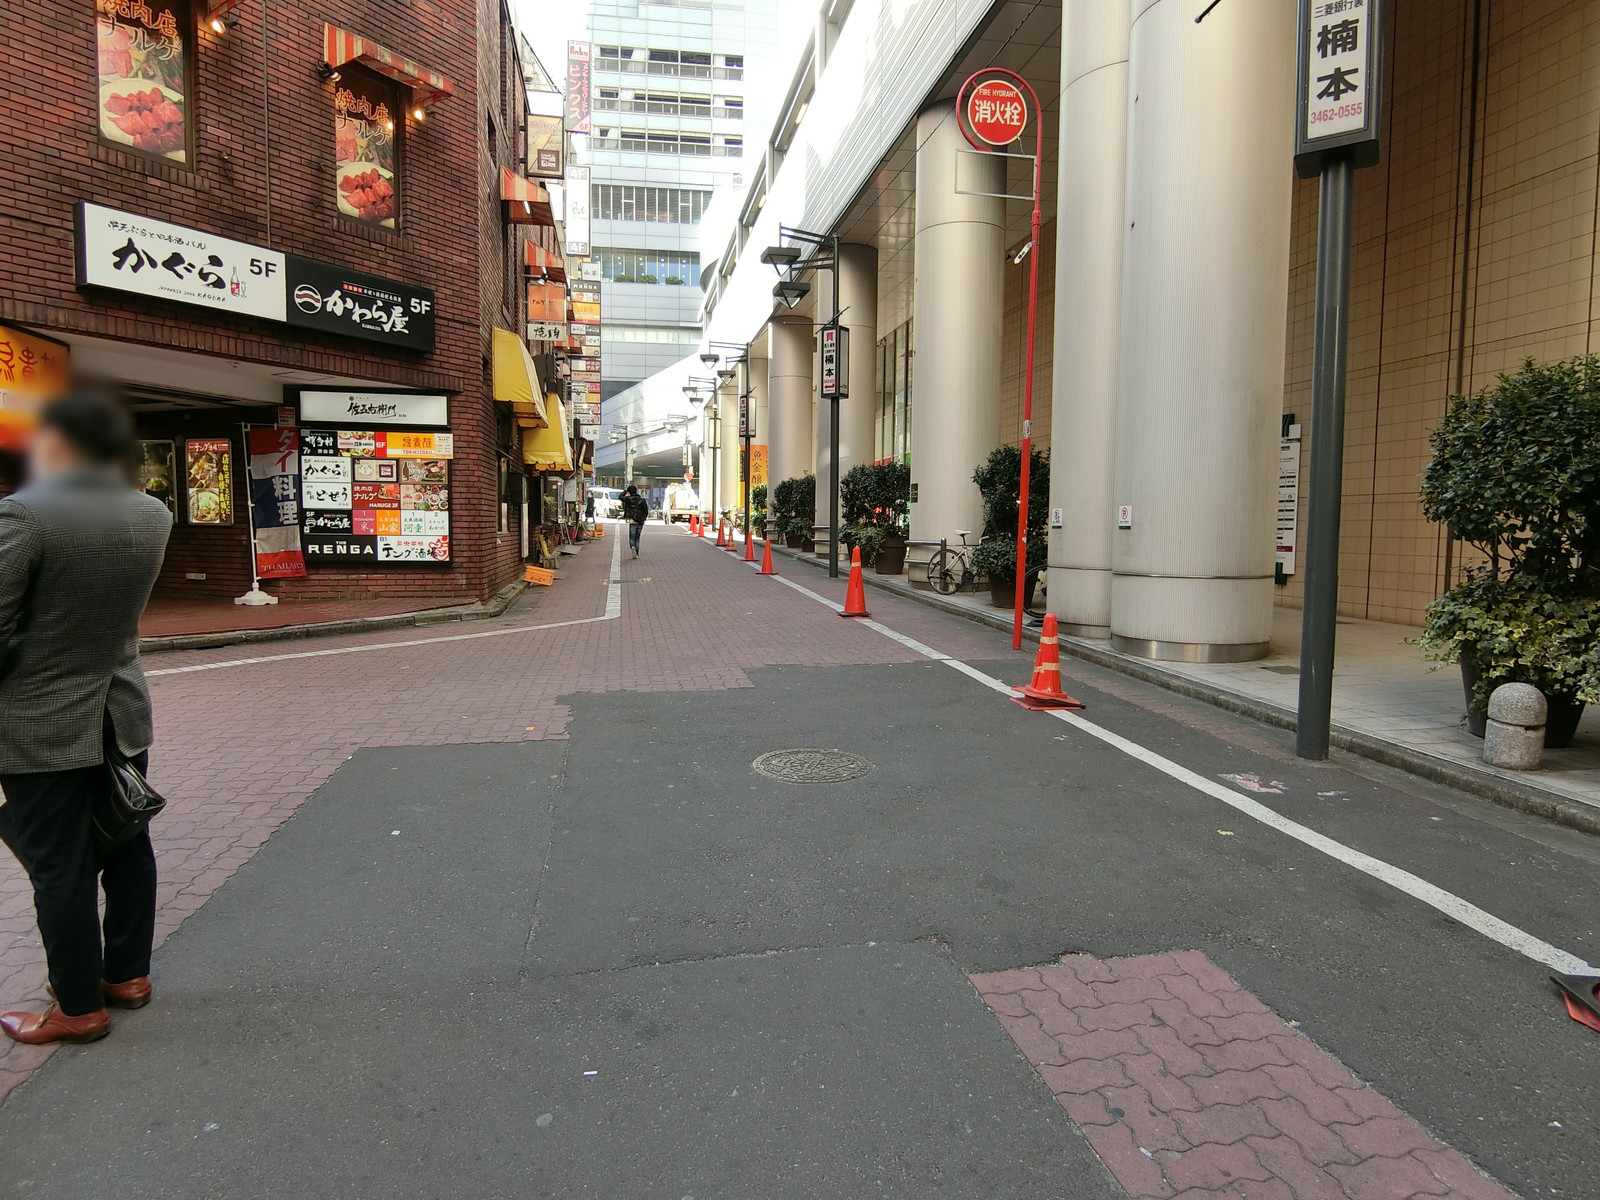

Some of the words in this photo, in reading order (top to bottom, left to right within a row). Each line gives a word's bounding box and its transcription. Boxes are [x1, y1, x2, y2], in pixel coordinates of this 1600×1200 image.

[1316, 18, 1360, 102] 楠本
[979, 88, 991, 97] FIRE
[992, 89, 1017, 98] HYDRANT
[336, 87, 389, 126] 焼肉店
[974, 99, 1022, 126] 消火栓
[1310, 102, 1363, 124] 3462-0555
[112, 237, 227, 290] かぐら
[249, 257, 278, 278] 5F
[322, 289, 410, 334] かわら屋
[409, 297, 432, 315] 5F
[302, 447, 312, 455] 7F
[375, 441, 386, 449] 6F
[274, 429, 299, 525] タイ料理
[304, 463, 342, 476] かぐら
[316, 486, 348, 502] どぜう
[353, 492, 378, 501] ナルゲ
[316, 516, 351, 529] かわら屋
[308, 543, 374, 554] RENGA
[382, 543, 438, 559] テング酒場
